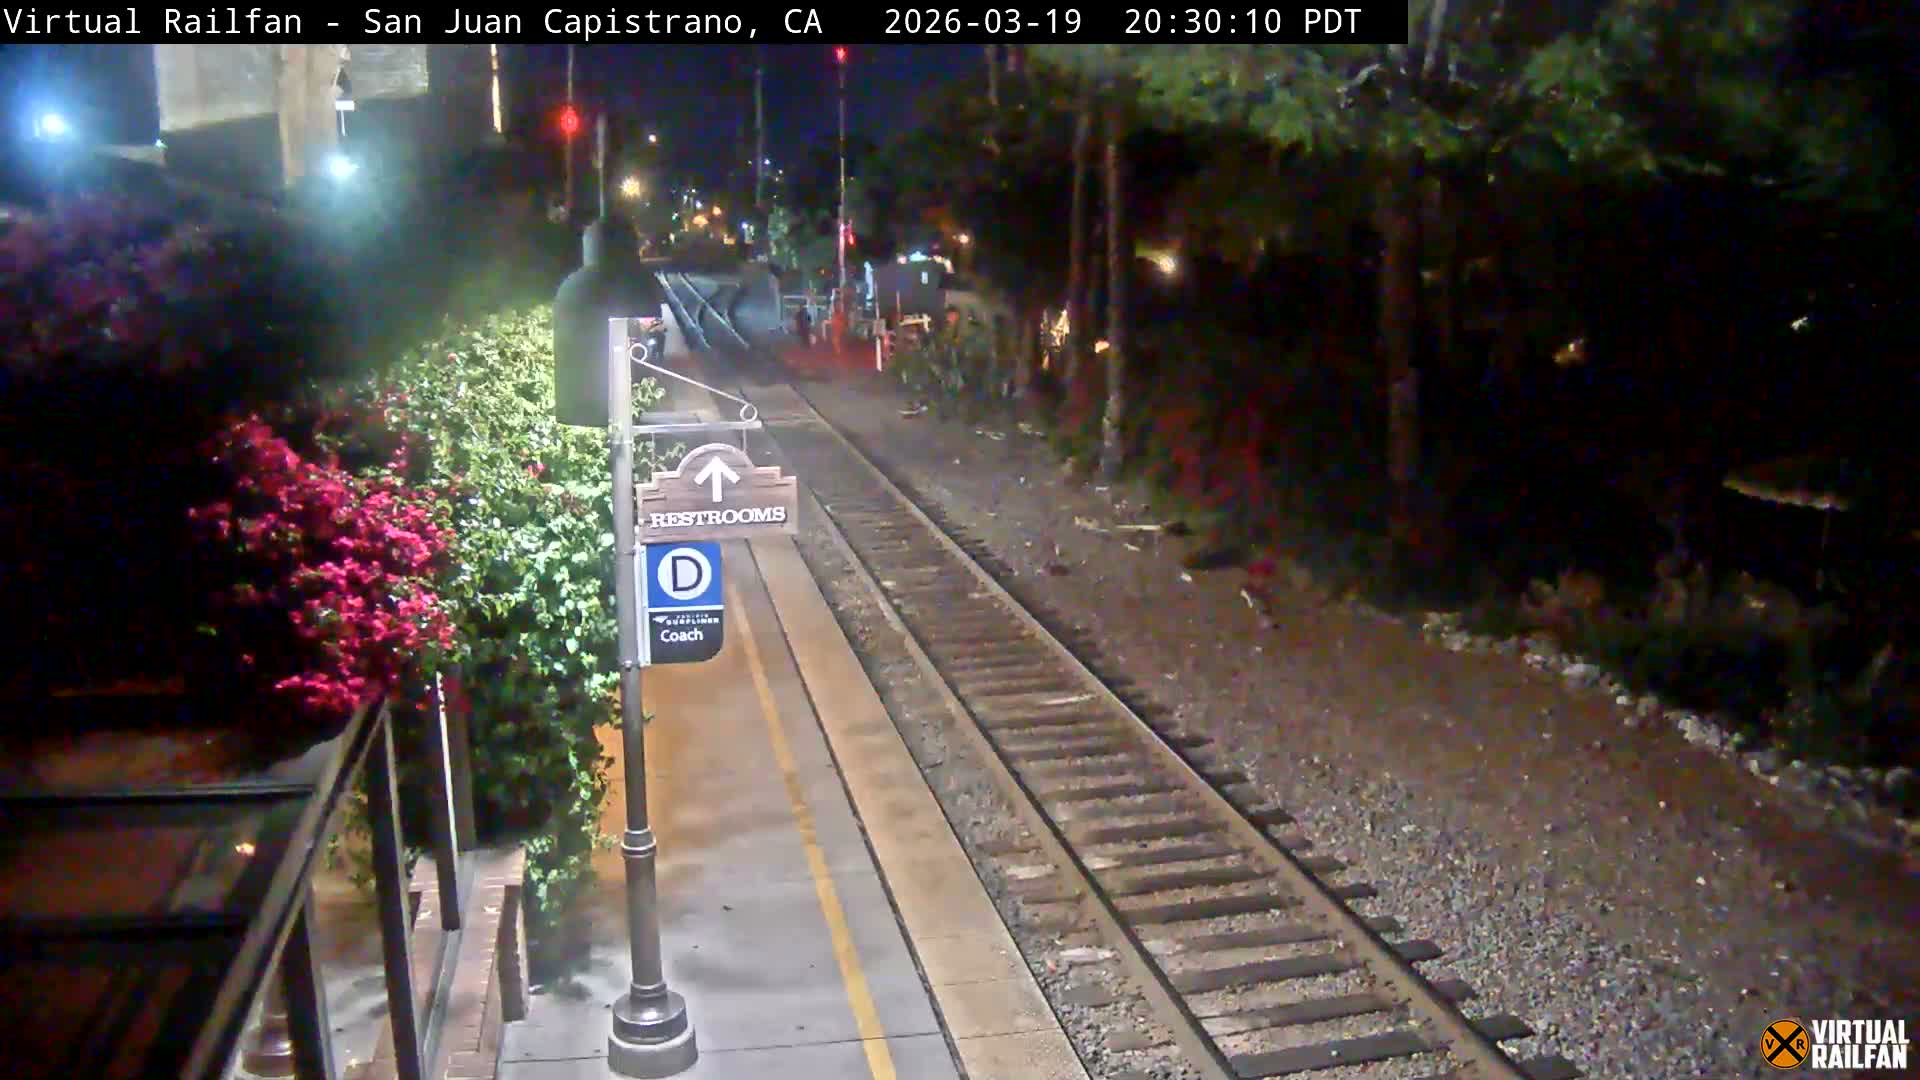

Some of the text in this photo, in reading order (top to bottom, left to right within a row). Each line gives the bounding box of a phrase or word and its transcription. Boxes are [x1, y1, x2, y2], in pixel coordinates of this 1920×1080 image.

[650, 506, 786, 528] RESTROOMS
[671, 555, 703, 592] D
[660, 627, 704, 643] Coach
